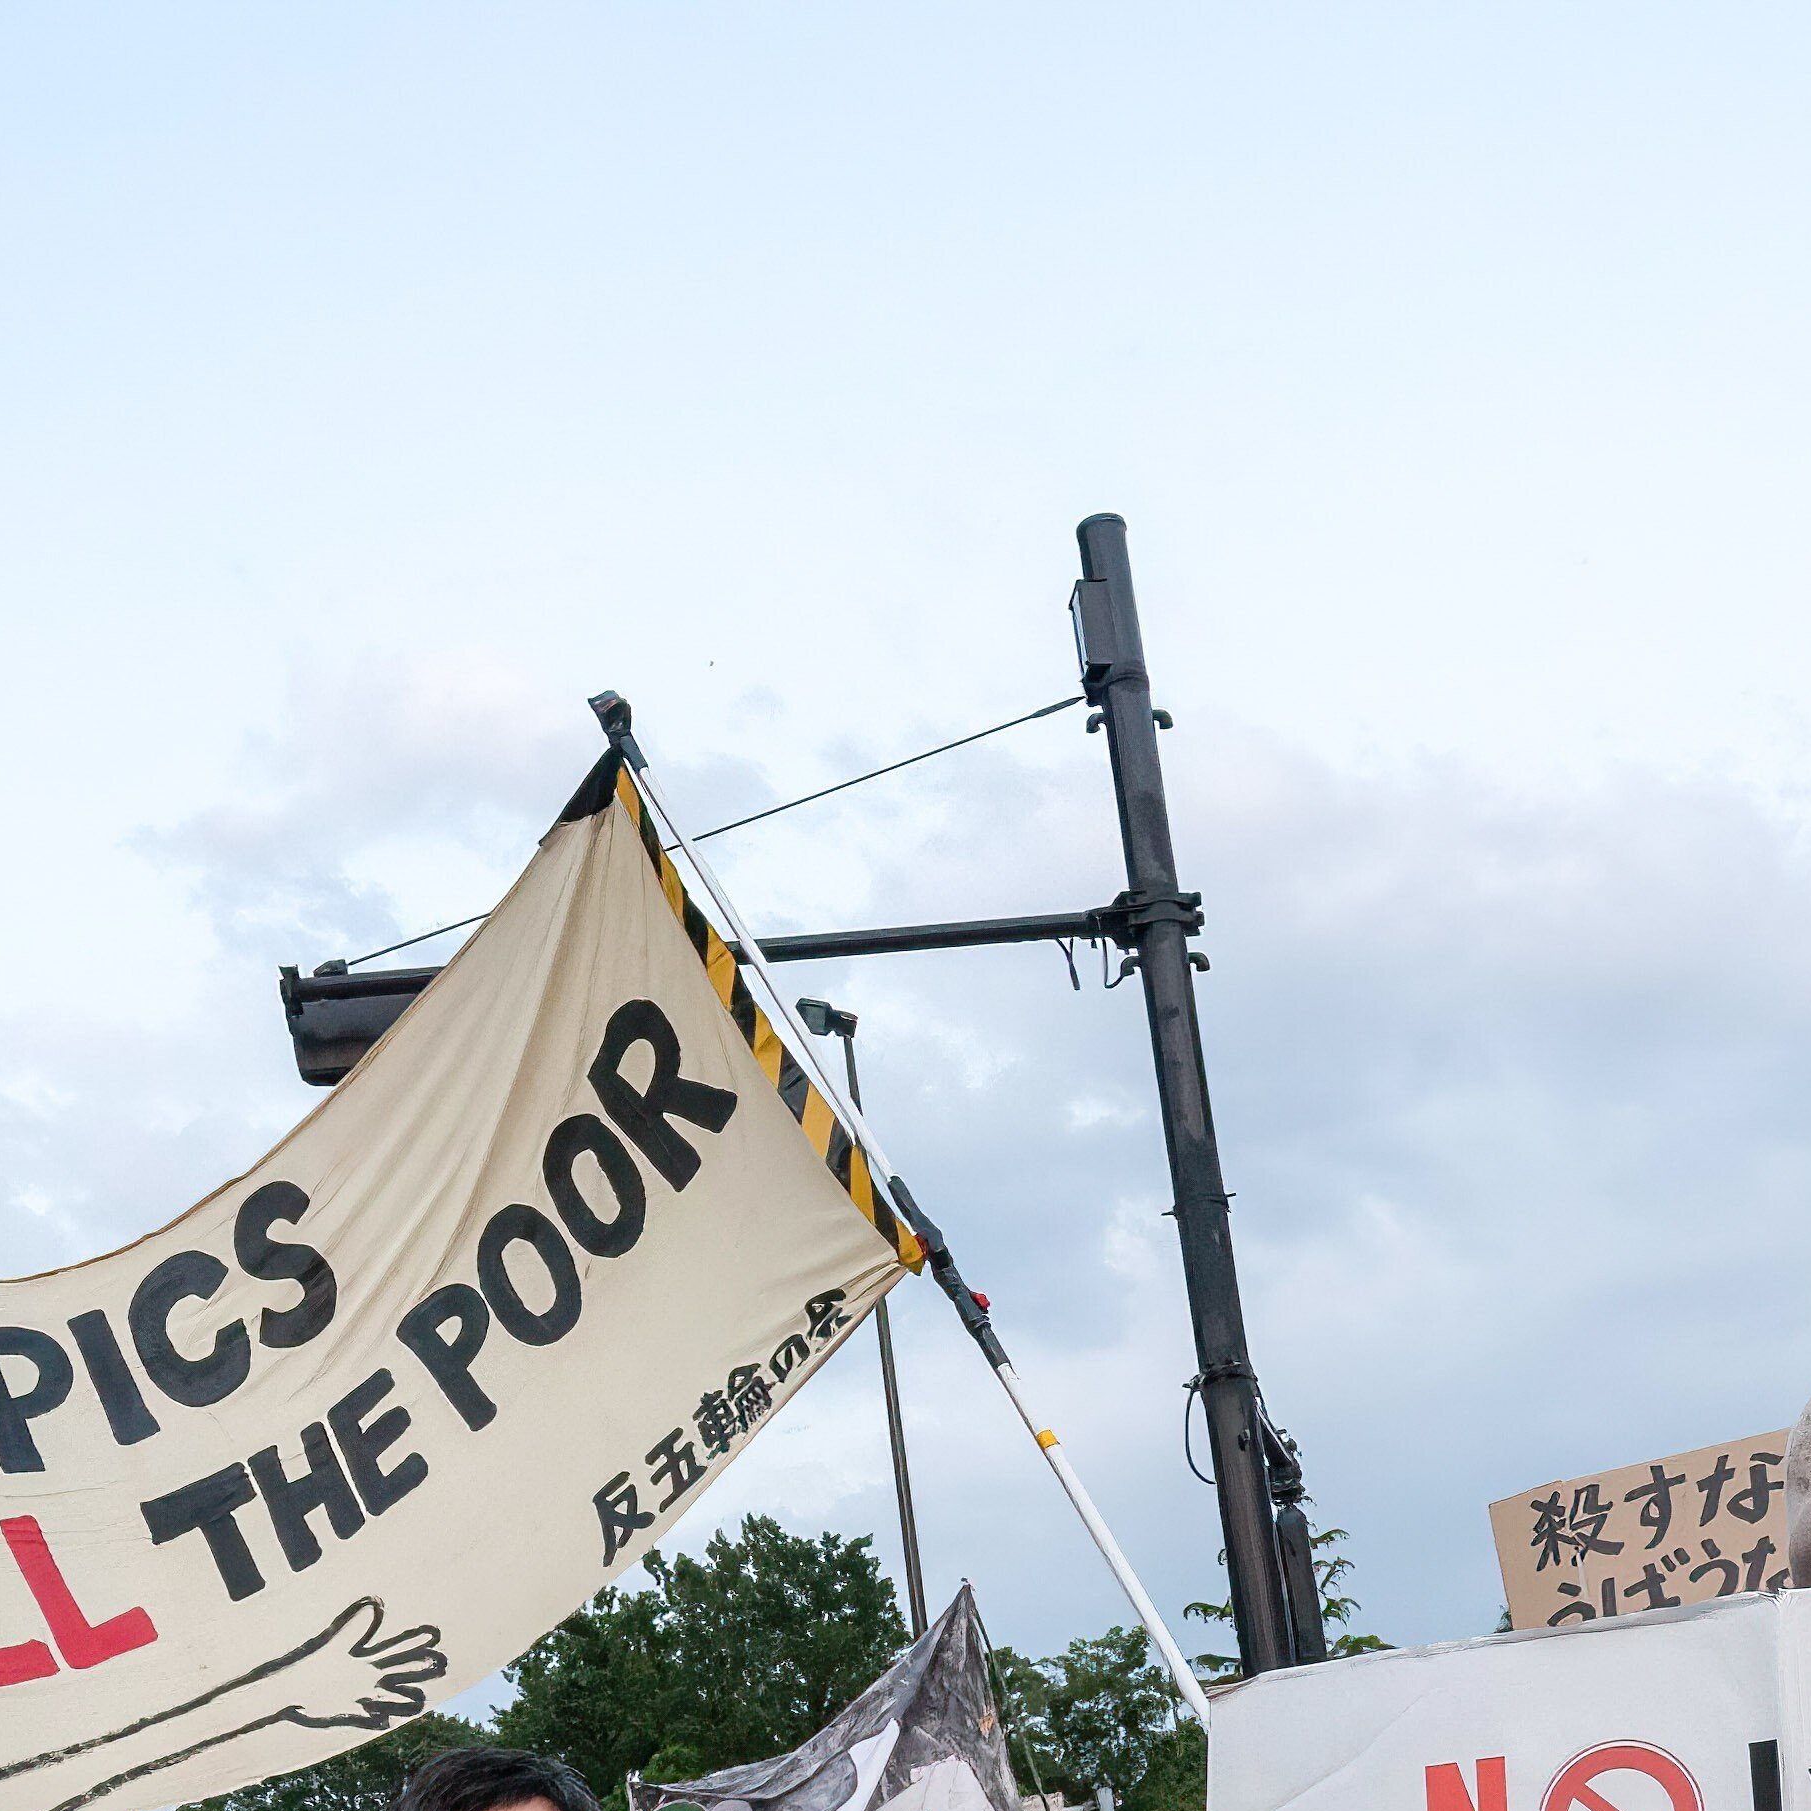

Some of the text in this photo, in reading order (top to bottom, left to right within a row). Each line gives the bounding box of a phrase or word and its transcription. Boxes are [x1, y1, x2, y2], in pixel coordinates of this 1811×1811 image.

[140, 1367, 429, 1601] THE
[396, 999, 738, 1433] POOR
[1530, 1452, 1785, 1572] 殺すな
